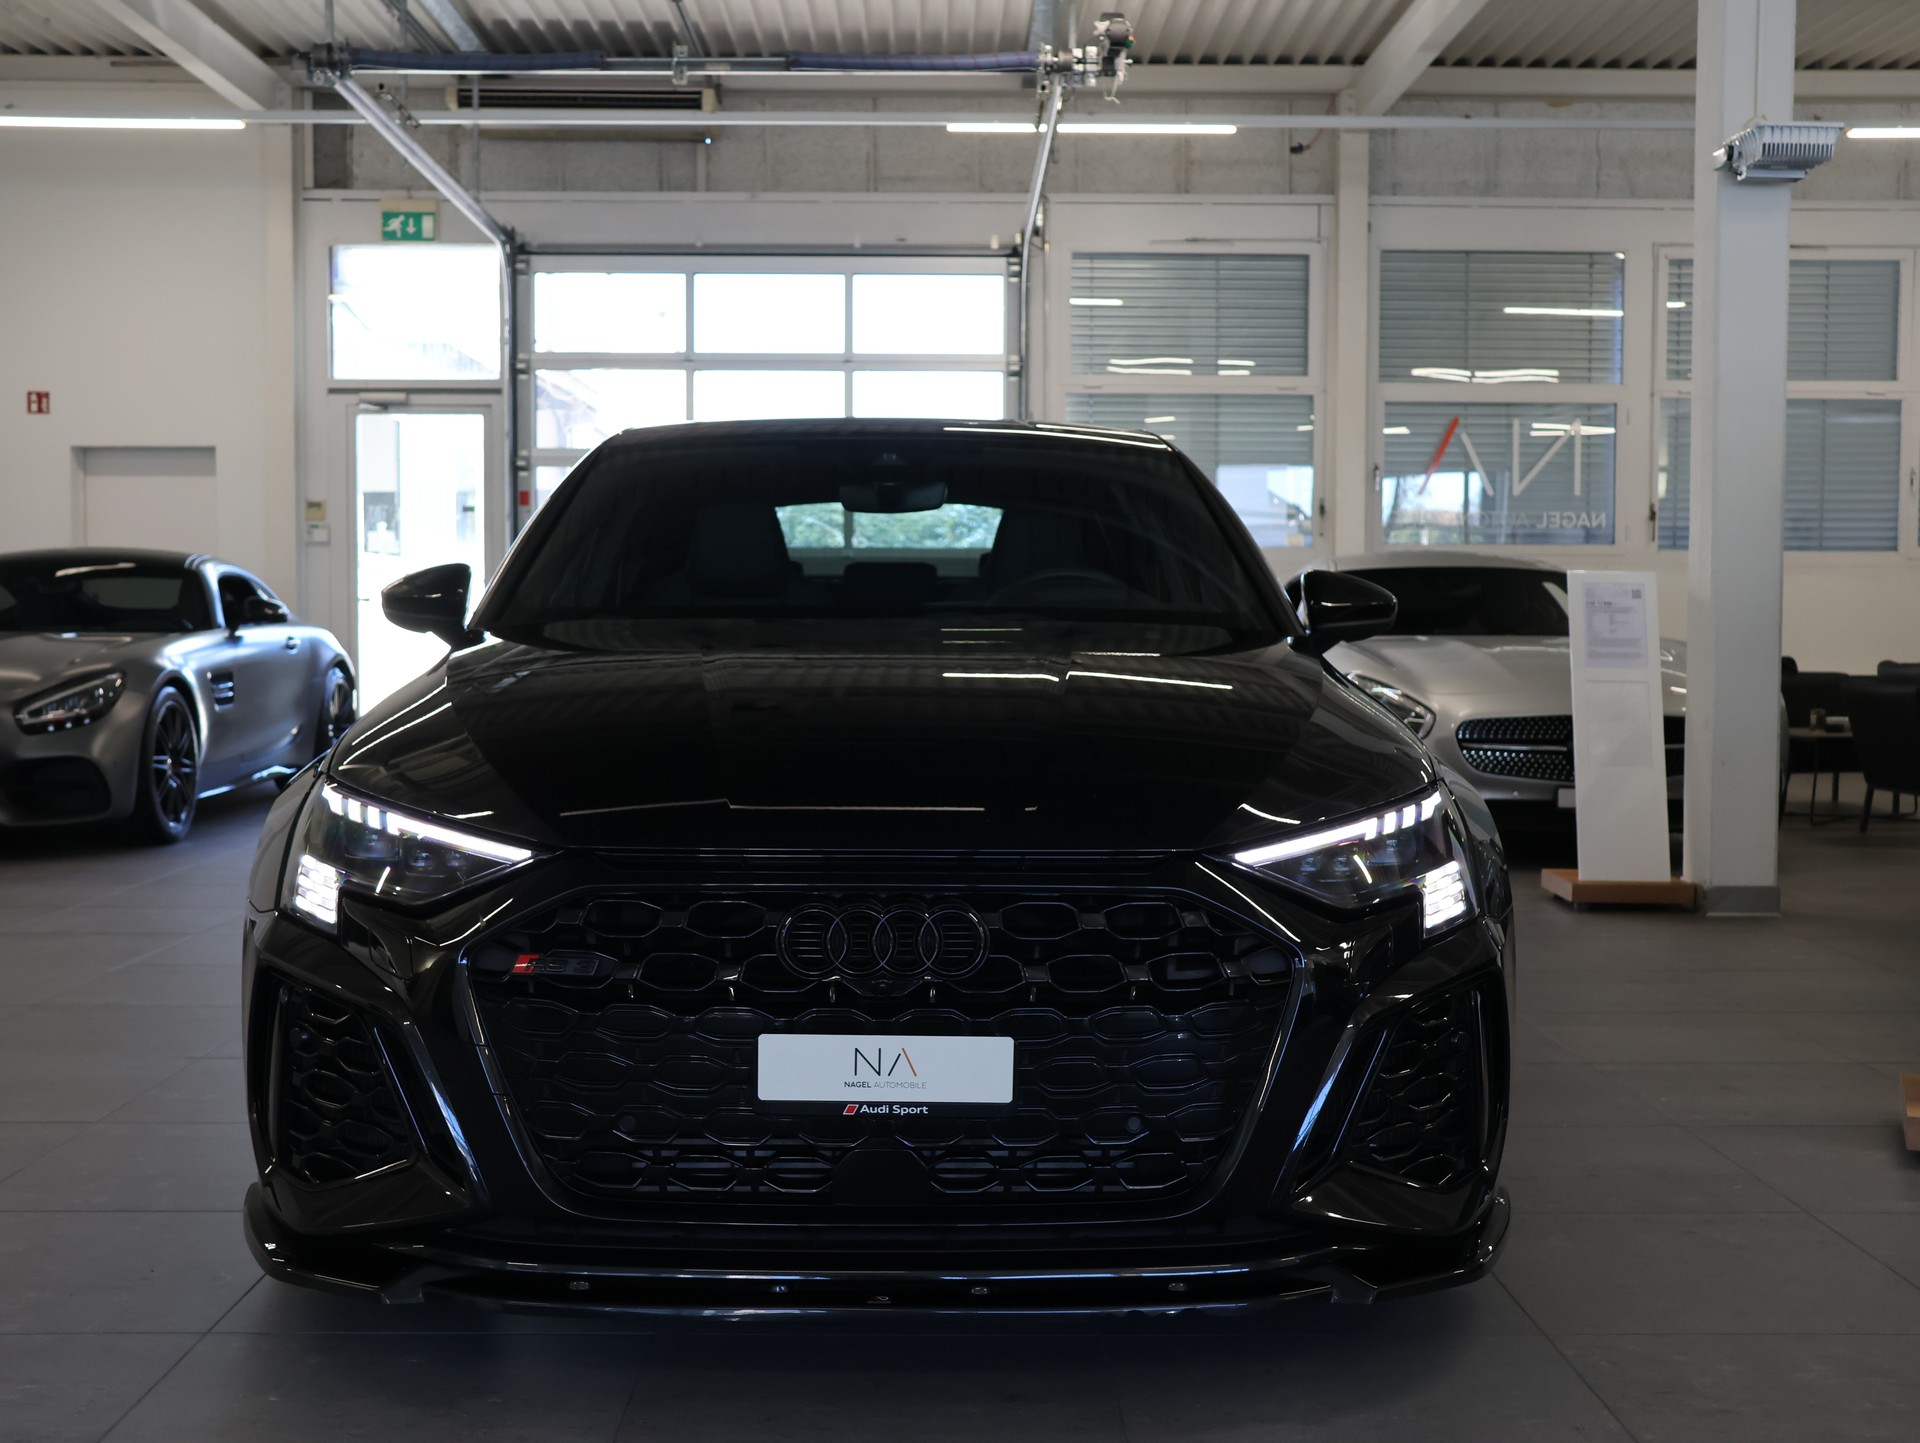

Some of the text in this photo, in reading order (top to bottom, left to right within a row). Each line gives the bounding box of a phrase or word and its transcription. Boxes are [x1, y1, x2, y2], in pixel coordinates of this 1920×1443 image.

[854, 1047, 917, 1077] NA
[843, 1081, 927, 1090] NAGEL AUTOMOBILE
[859, 1104, 929, 1116] Audi Sport
